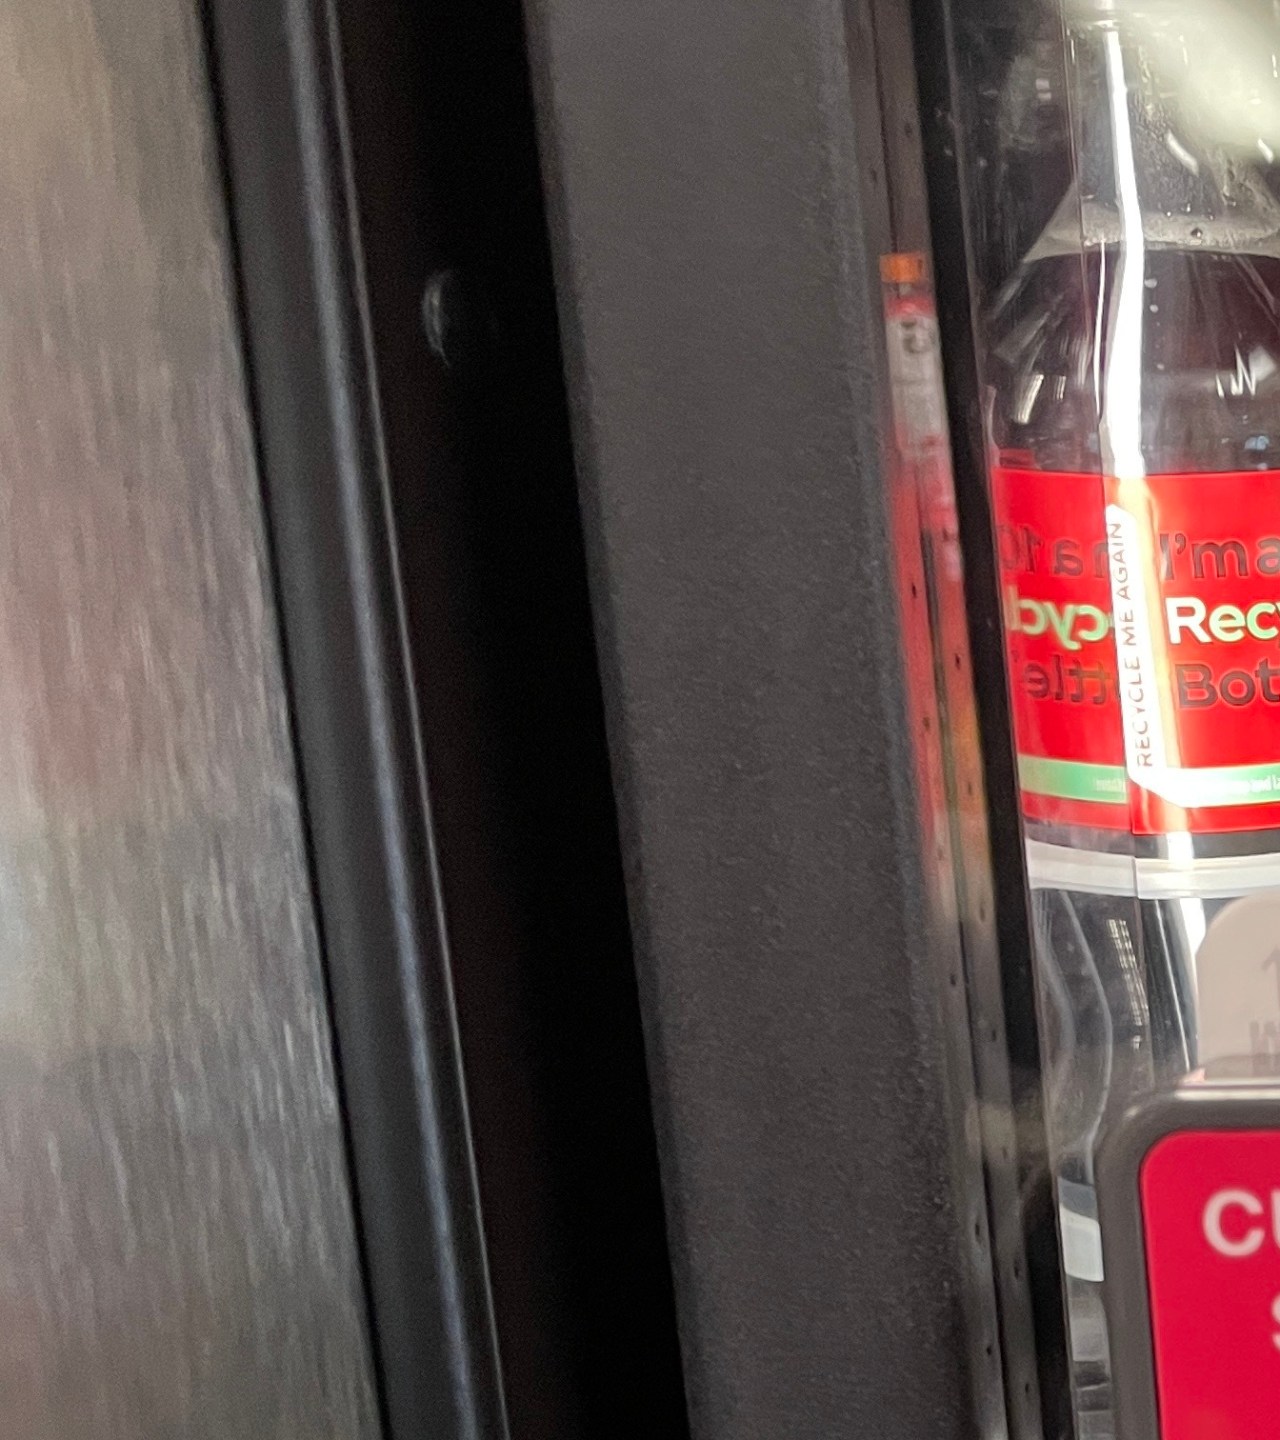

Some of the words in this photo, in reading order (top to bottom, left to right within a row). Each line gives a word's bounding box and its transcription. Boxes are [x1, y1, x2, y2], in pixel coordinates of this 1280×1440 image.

[1108, 522, 1134, 600] AGAIN
[1158, 532, 1251, 581] I'm
[1117, 607, 1135, 647] ME
[1122, 655, 1154, 768] RECYCLE
